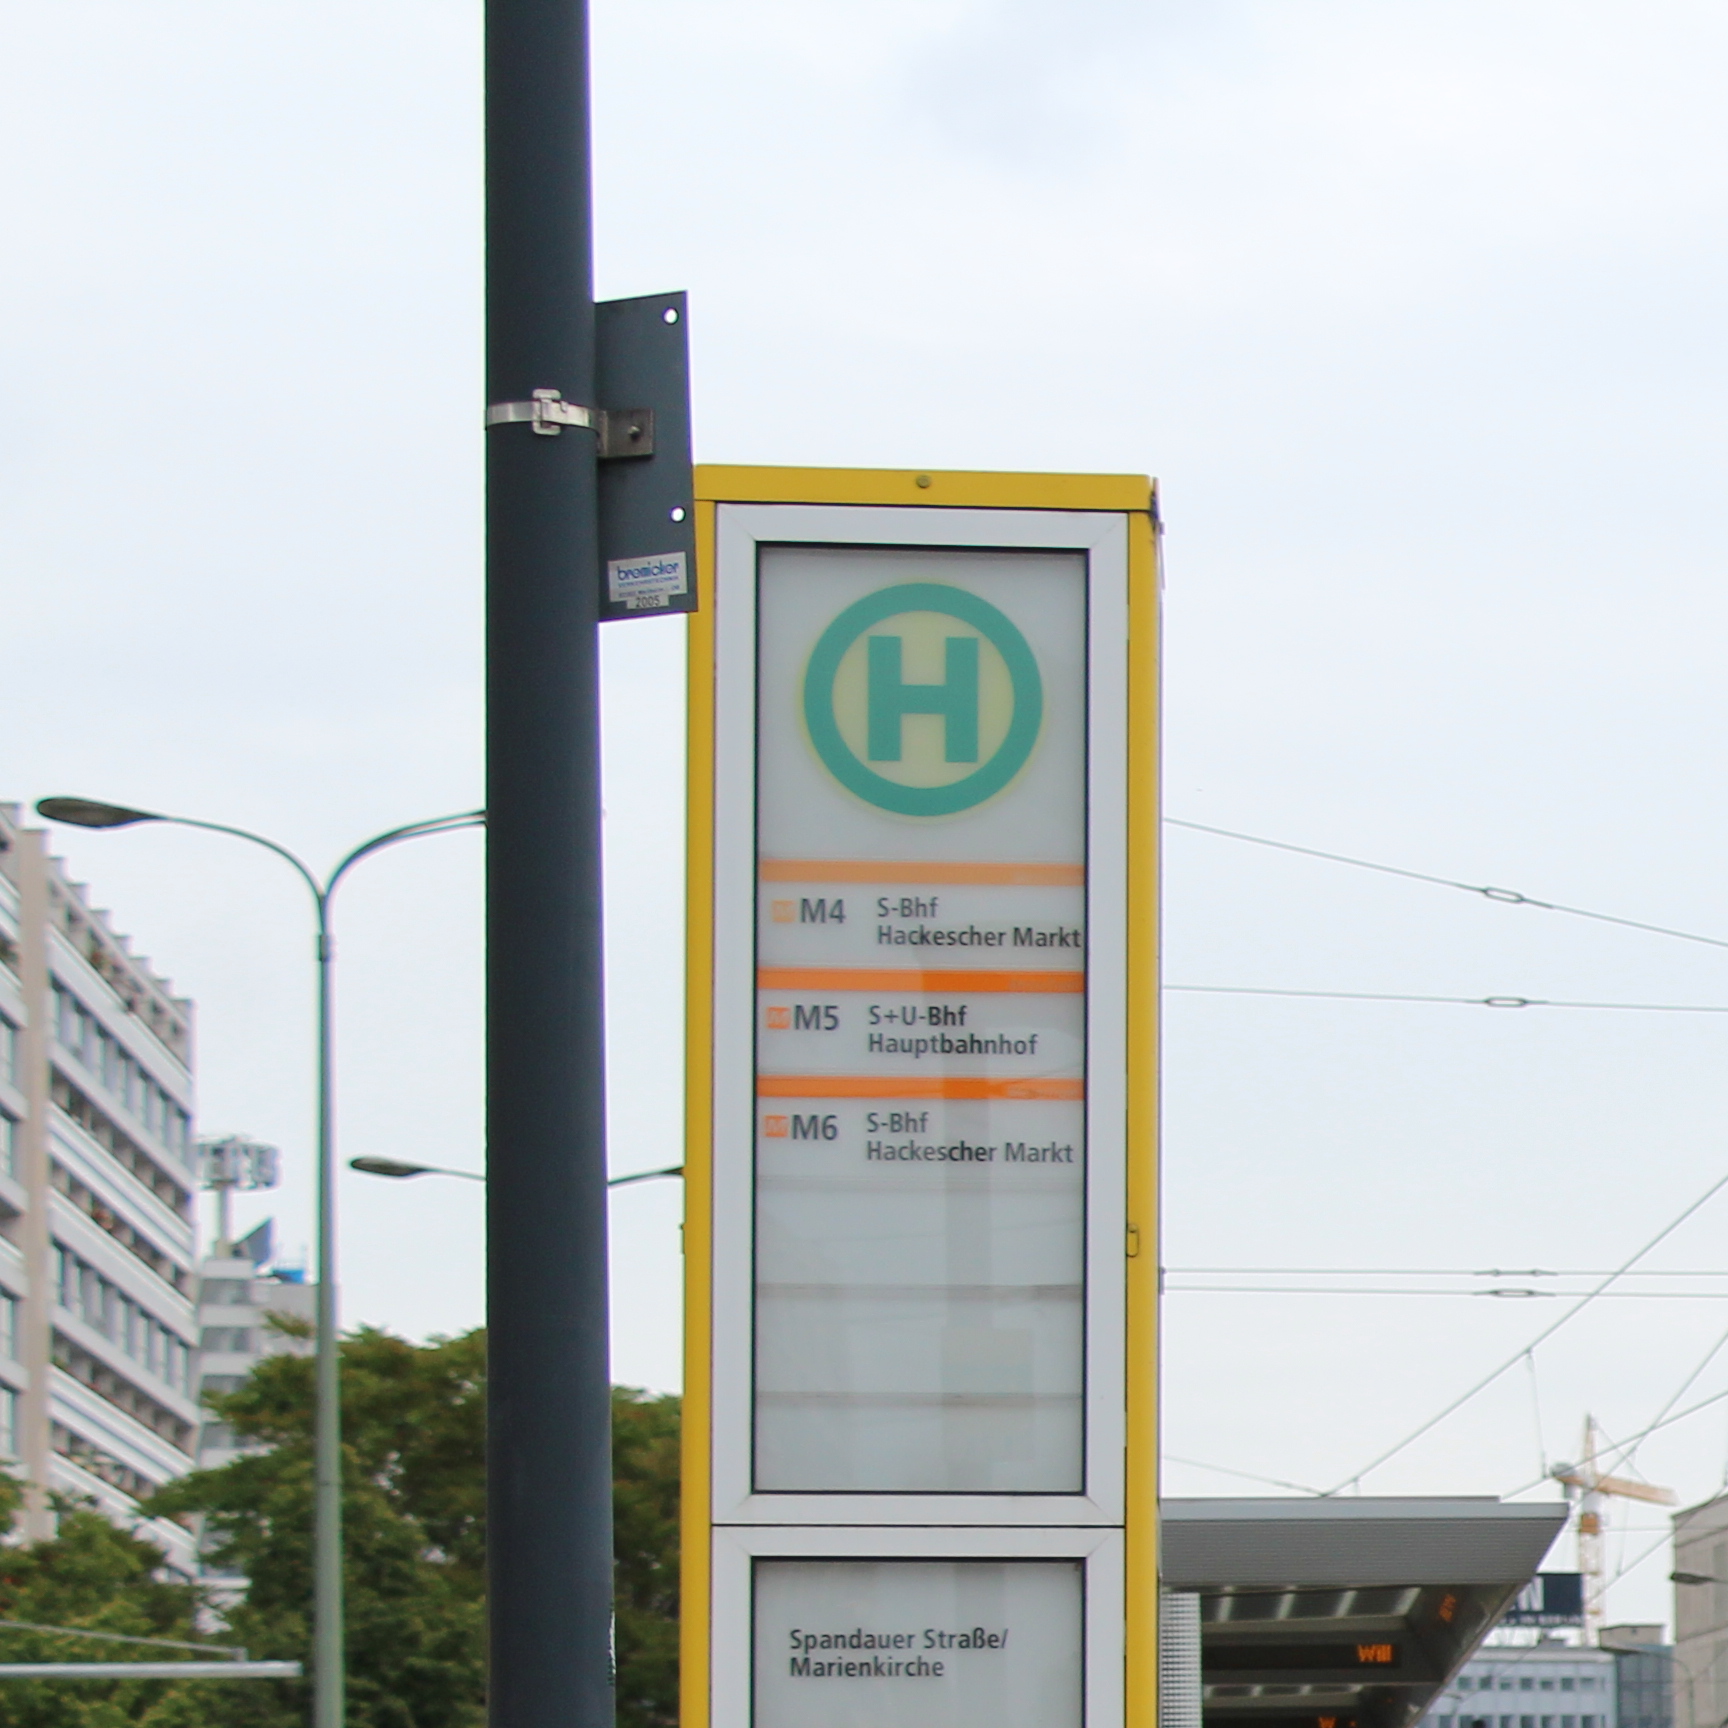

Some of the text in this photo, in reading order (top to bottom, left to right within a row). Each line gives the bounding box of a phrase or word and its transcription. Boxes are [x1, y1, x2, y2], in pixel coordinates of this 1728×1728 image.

[800, 898, 847, 924] M4
[877, 897, 939, 919] S-Bhf
[877, 924, 1082, 949] Hackescher Markt
[794, 1005, 840, 1030] M5
[868, 1006, 968, 1027] S+U-Bhf
[868, 1033, 1039, 1058] Hauptbahnhof
[792, 1115, 839, 1141] M6
[866, 1112, 930, 1134] S-Bhf
[866, 1140, 1075, 1164] Hackescher Markt
[790, 1627, 1009, 1653] Spandauer Straße/
[790, 1656, 944, 1677] Marienkirche
